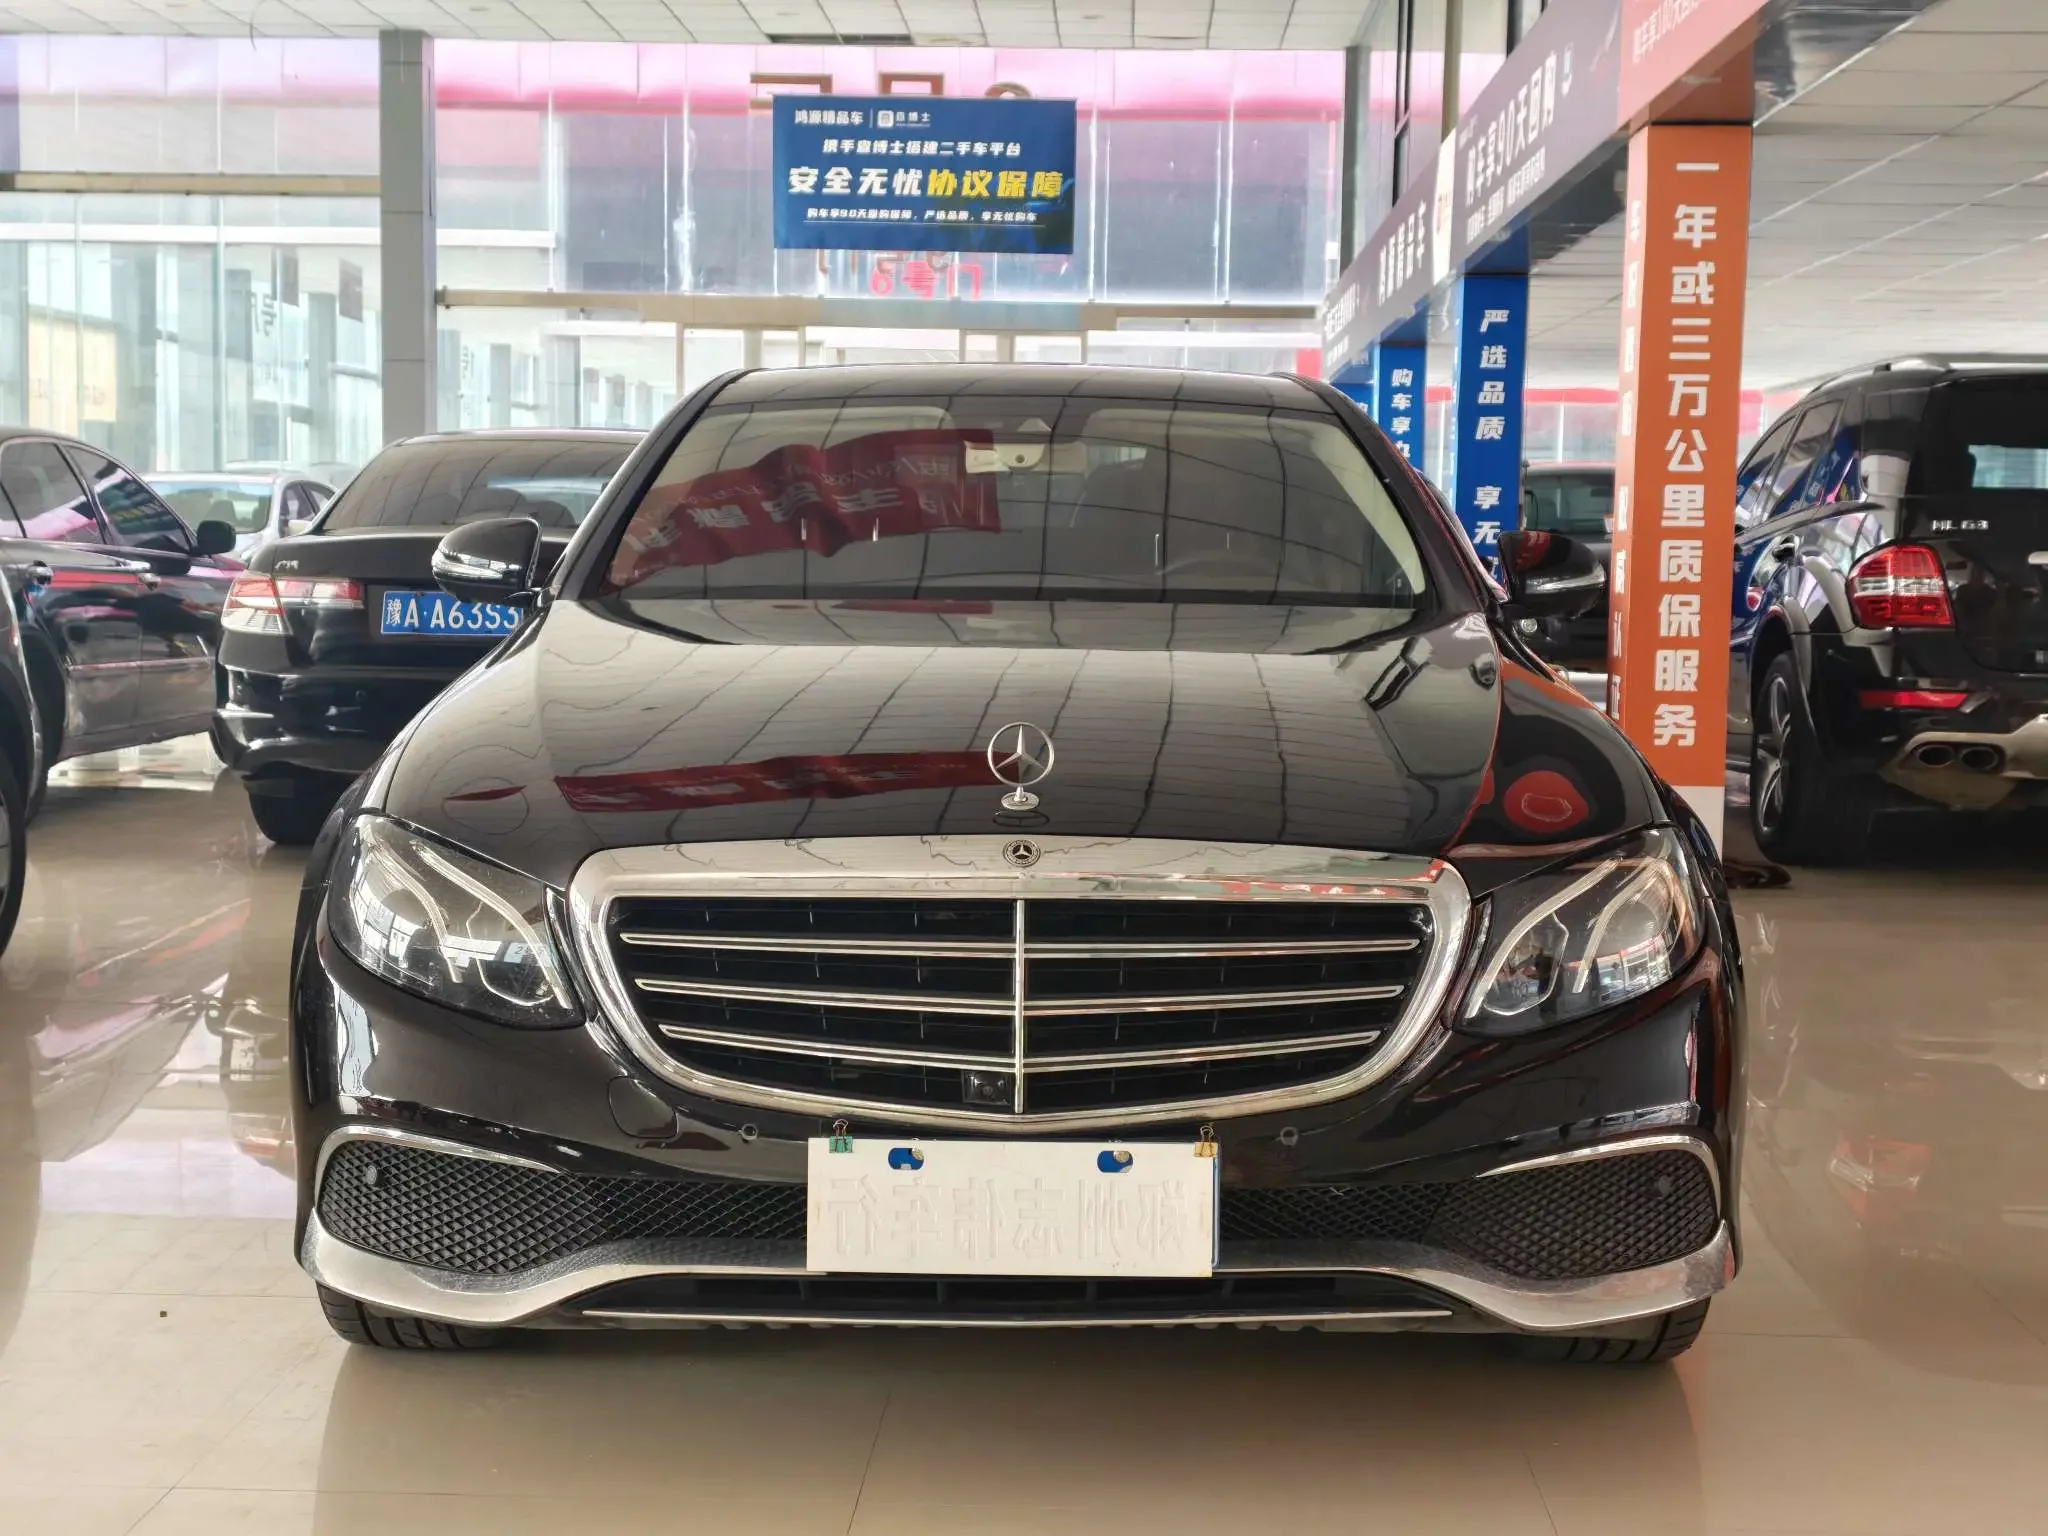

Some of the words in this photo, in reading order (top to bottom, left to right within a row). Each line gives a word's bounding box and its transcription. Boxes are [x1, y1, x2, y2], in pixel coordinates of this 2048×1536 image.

[788, 166, 1063, 198] 安全无忧协议保障
[1475, 310, 1510, 440] 严选品质
[1653, 162, 1720, 747] 一年或三万公里质保服务
